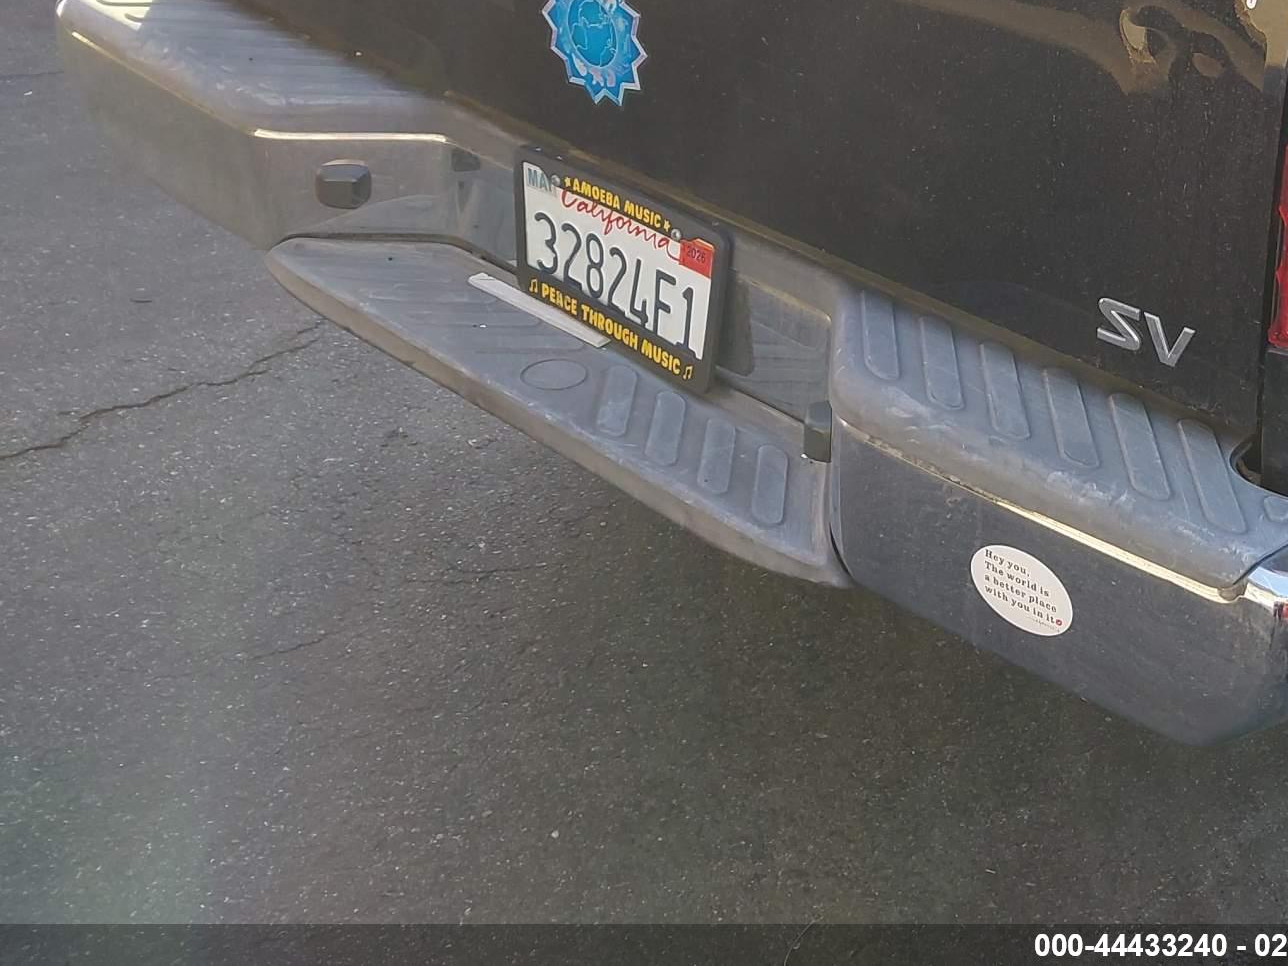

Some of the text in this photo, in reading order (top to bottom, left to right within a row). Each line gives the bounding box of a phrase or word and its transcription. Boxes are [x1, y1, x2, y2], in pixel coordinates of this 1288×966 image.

[572, 178, 662, 228] AMOEBA MUSIC
[561, 189, 683, 265] California
[686, 245, 706, 264] 2026
[534, 211, 695, 350] 32824F1
[541, 283, 681, 375] PEACE THROUGH MUSIC
[1096, 297, 1196, 368] SV
[985, 549, 1005, 565] Hey
[985, 560, 1049, 597] The world is
[984, 585, 1008, 602] with
[1011, 599, 1030, 612] you
[1033, 607, 1043, 618] in
[1046, 613, 1055, 624] it
[993, 576, 1026, 598] better
[1029, 595, 1057, 613] place
